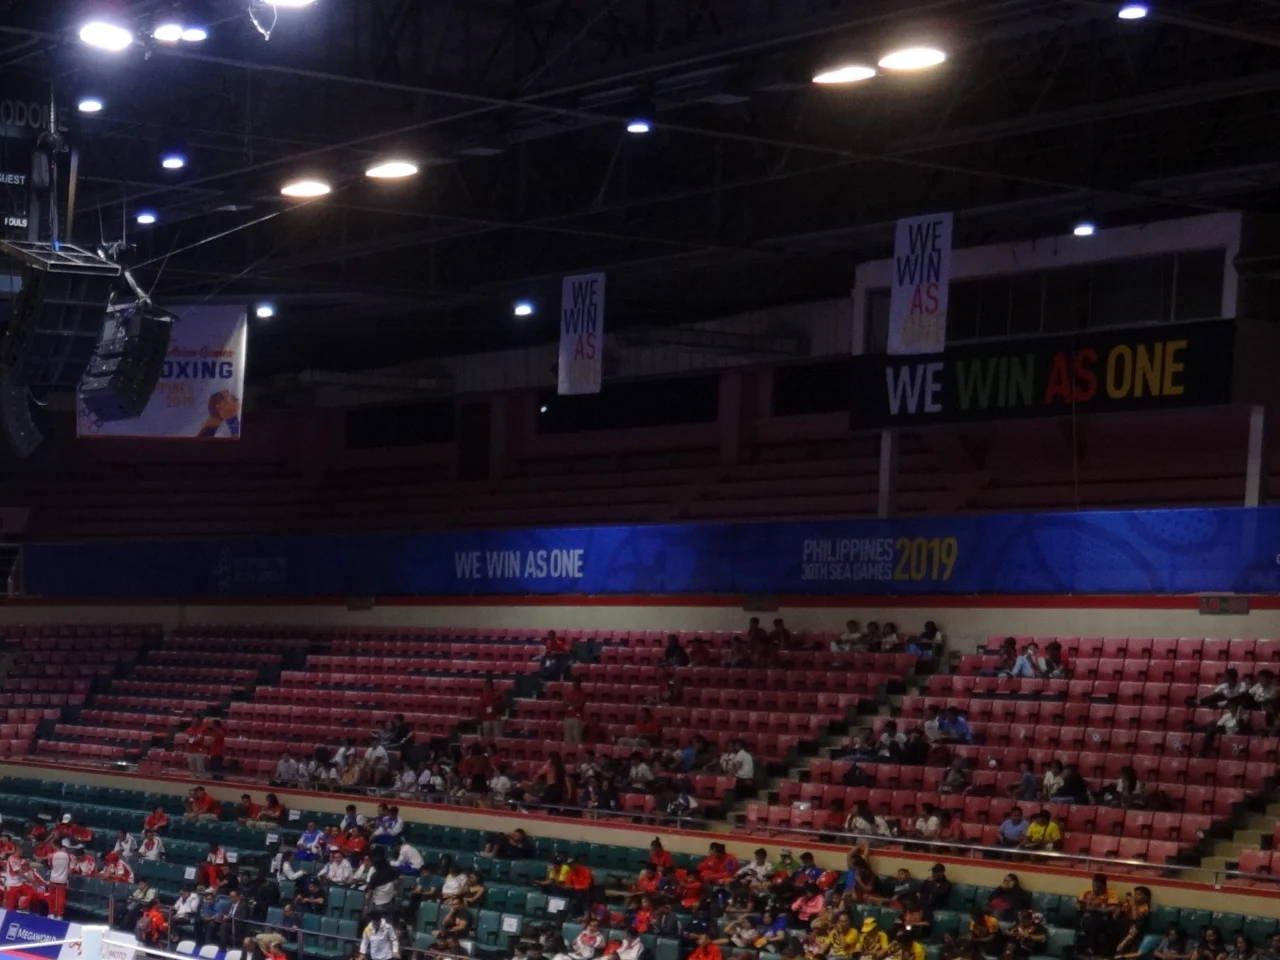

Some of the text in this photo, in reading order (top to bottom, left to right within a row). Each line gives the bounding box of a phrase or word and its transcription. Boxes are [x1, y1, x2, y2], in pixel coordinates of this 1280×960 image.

[909, 221, 943, 254] WE
[897, 249, 941, 286] WIN
[572, 280, 598, 308] WE
[910, 282, 938, 314] AS
[564, 305, 597, 335] WIN
[575, 332, 596, 360] AS
[885, 339, 1188, 416] WE WIN AS ONE
[454, 549, 584, 579] WE WIN AS ONE
[802, 537, 959, 580] PHILIPPINES 2019
[830, 563, 852, 580] SEA
[854, 562, 893, 579] GAMES
